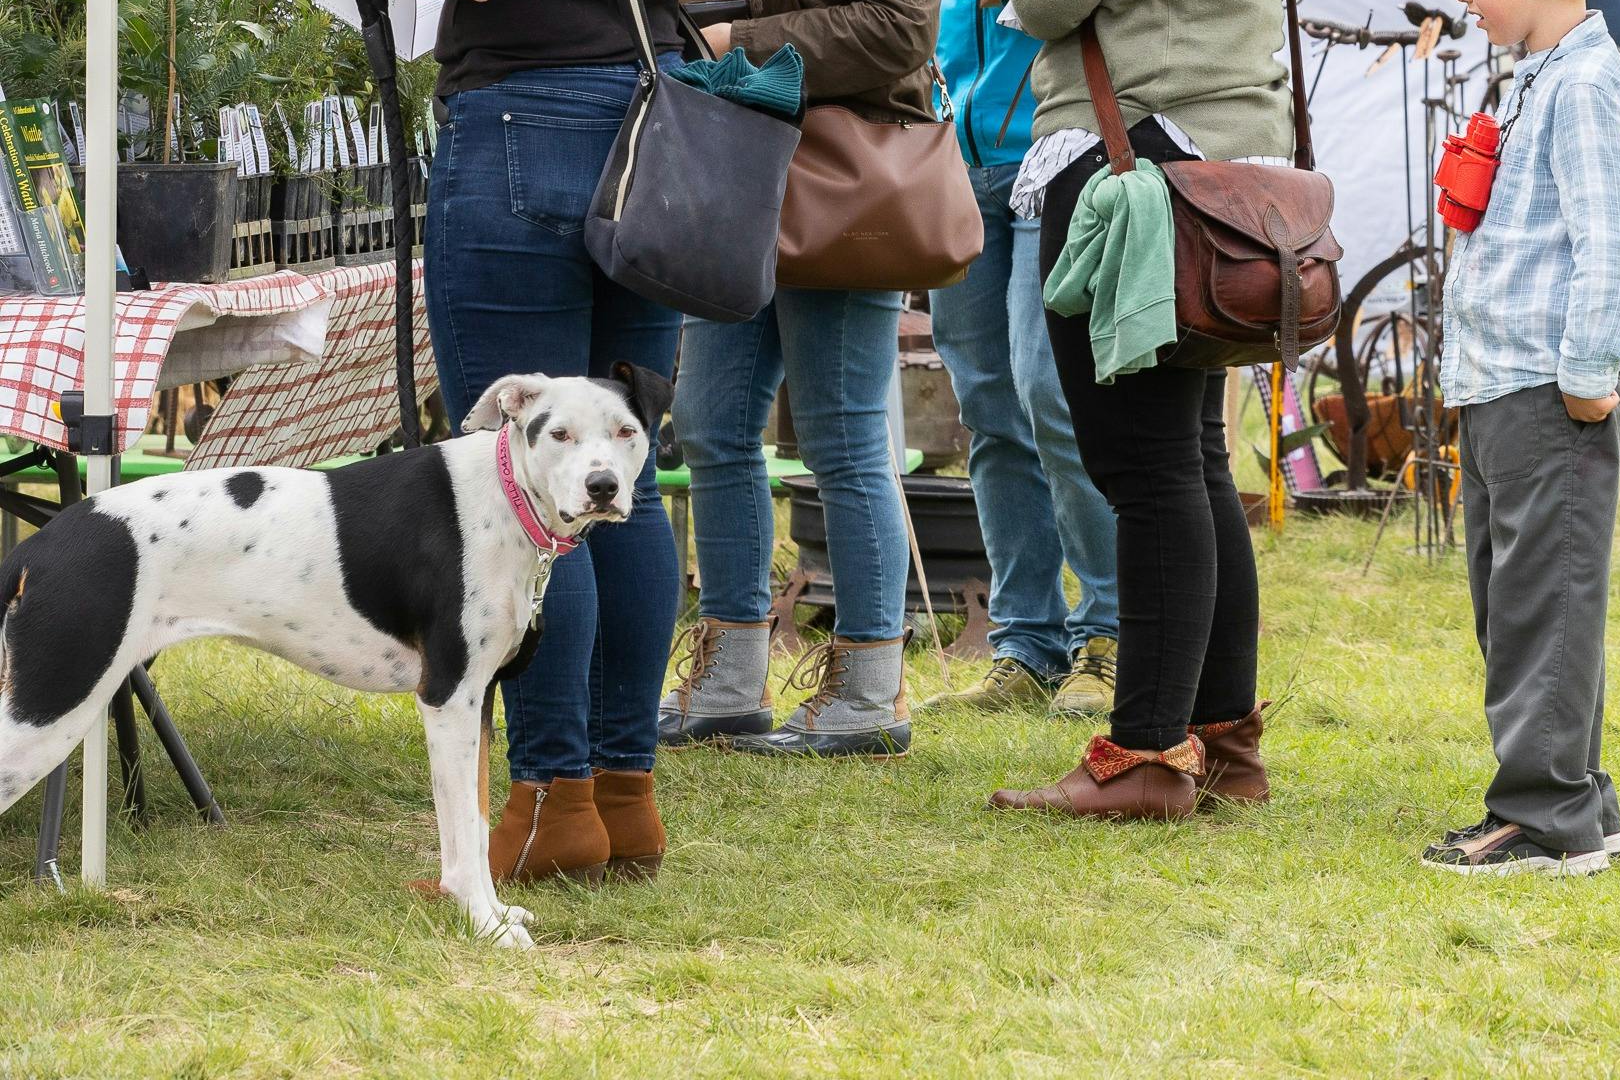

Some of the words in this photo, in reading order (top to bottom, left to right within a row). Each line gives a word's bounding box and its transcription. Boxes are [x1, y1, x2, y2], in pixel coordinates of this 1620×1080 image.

[0, 117, 21, 167] Celebration
[15, 168, 26, 178] of
[20, 123, 43, 143] Wattle
[30, 217, 42, 239] Maria
[38, 239, 55, 274] Hitchcock
[504, 479, 523, 510] TILLY
